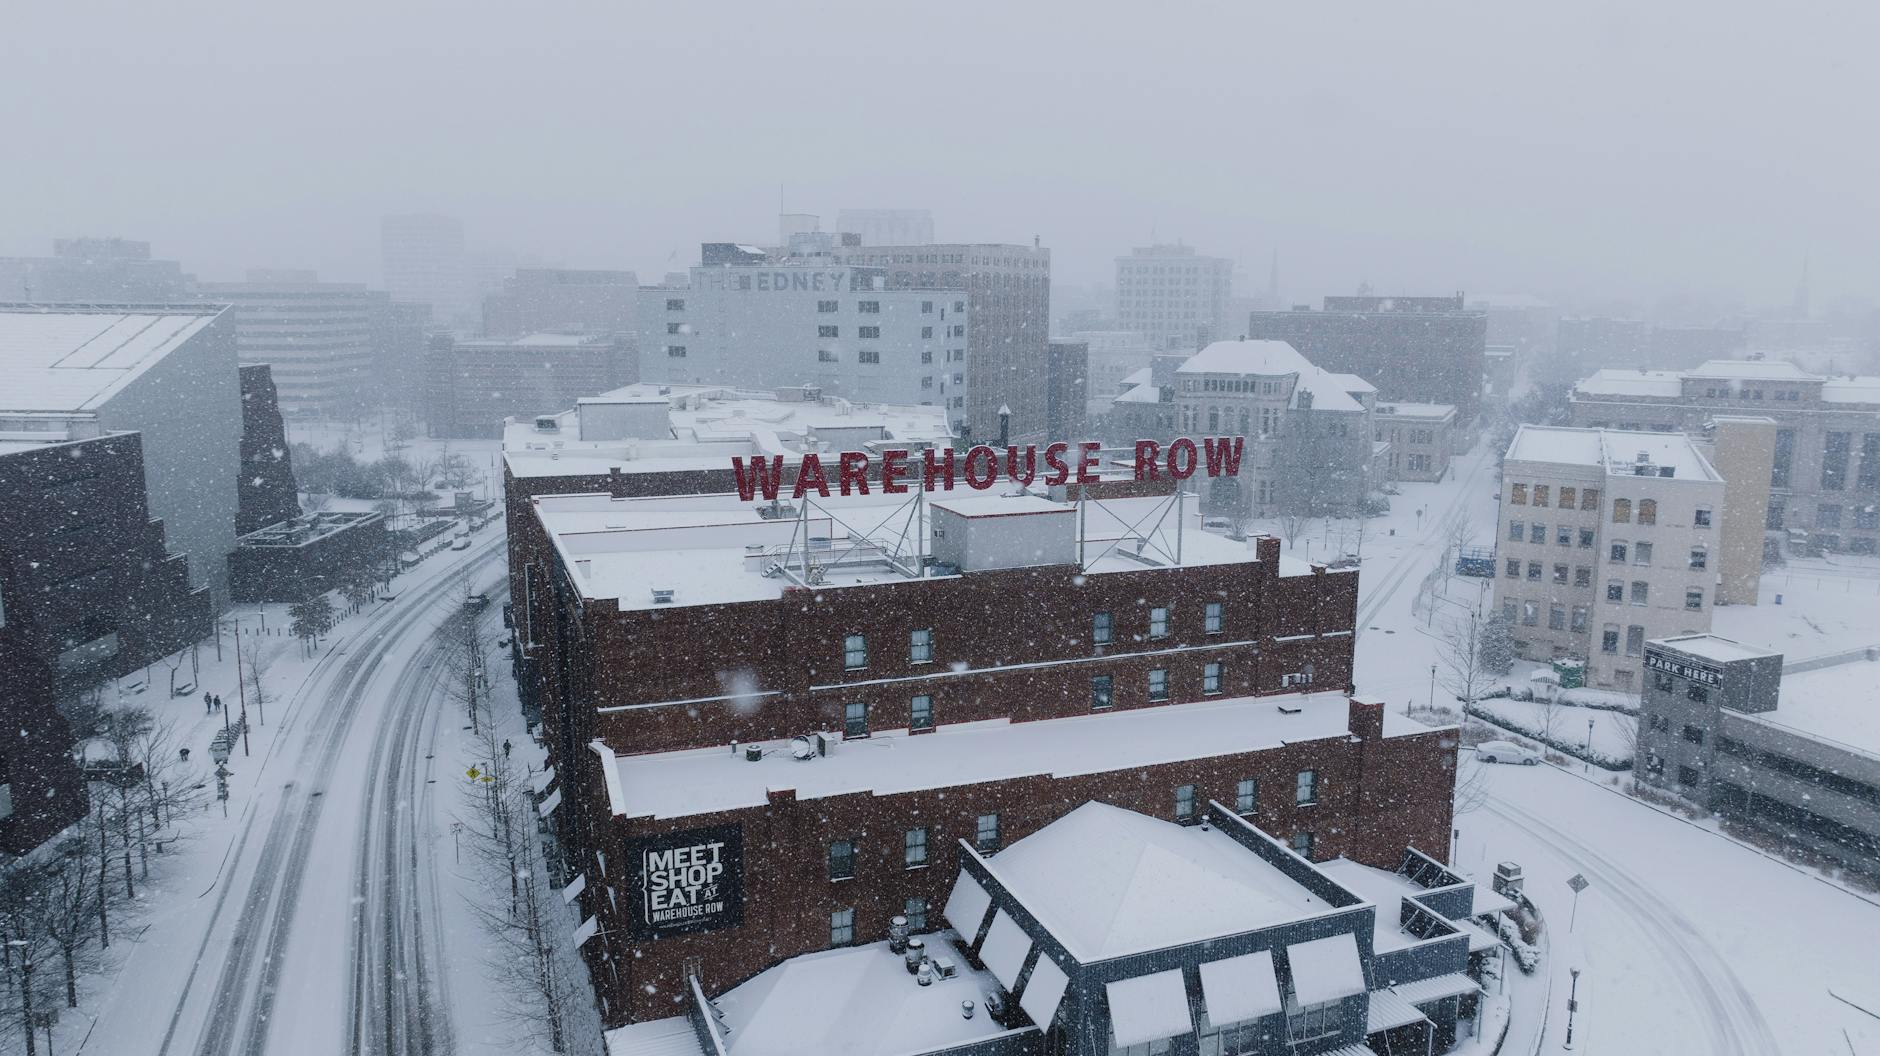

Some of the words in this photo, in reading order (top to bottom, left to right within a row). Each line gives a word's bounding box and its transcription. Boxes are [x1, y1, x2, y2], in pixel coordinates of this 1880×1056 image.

[758, 272, 845, 291] EDNEY
[732, 440, 1101, 501] WAREHOUSE
[1135, 436, 1244, 481] ROW
[1649, 657, 1681, 673] PARK
[1684, 667, 1715, 683] HERE
[649, 842, 724, 871] MEET
[650, 862, 723, 891] SHOP
[651, 885, 702, 910] EAT
[704, 886, 717, 898] AT
[652, 905, 704, 922] WAREHOUSE
[705, 902, 724, 914] ROW
